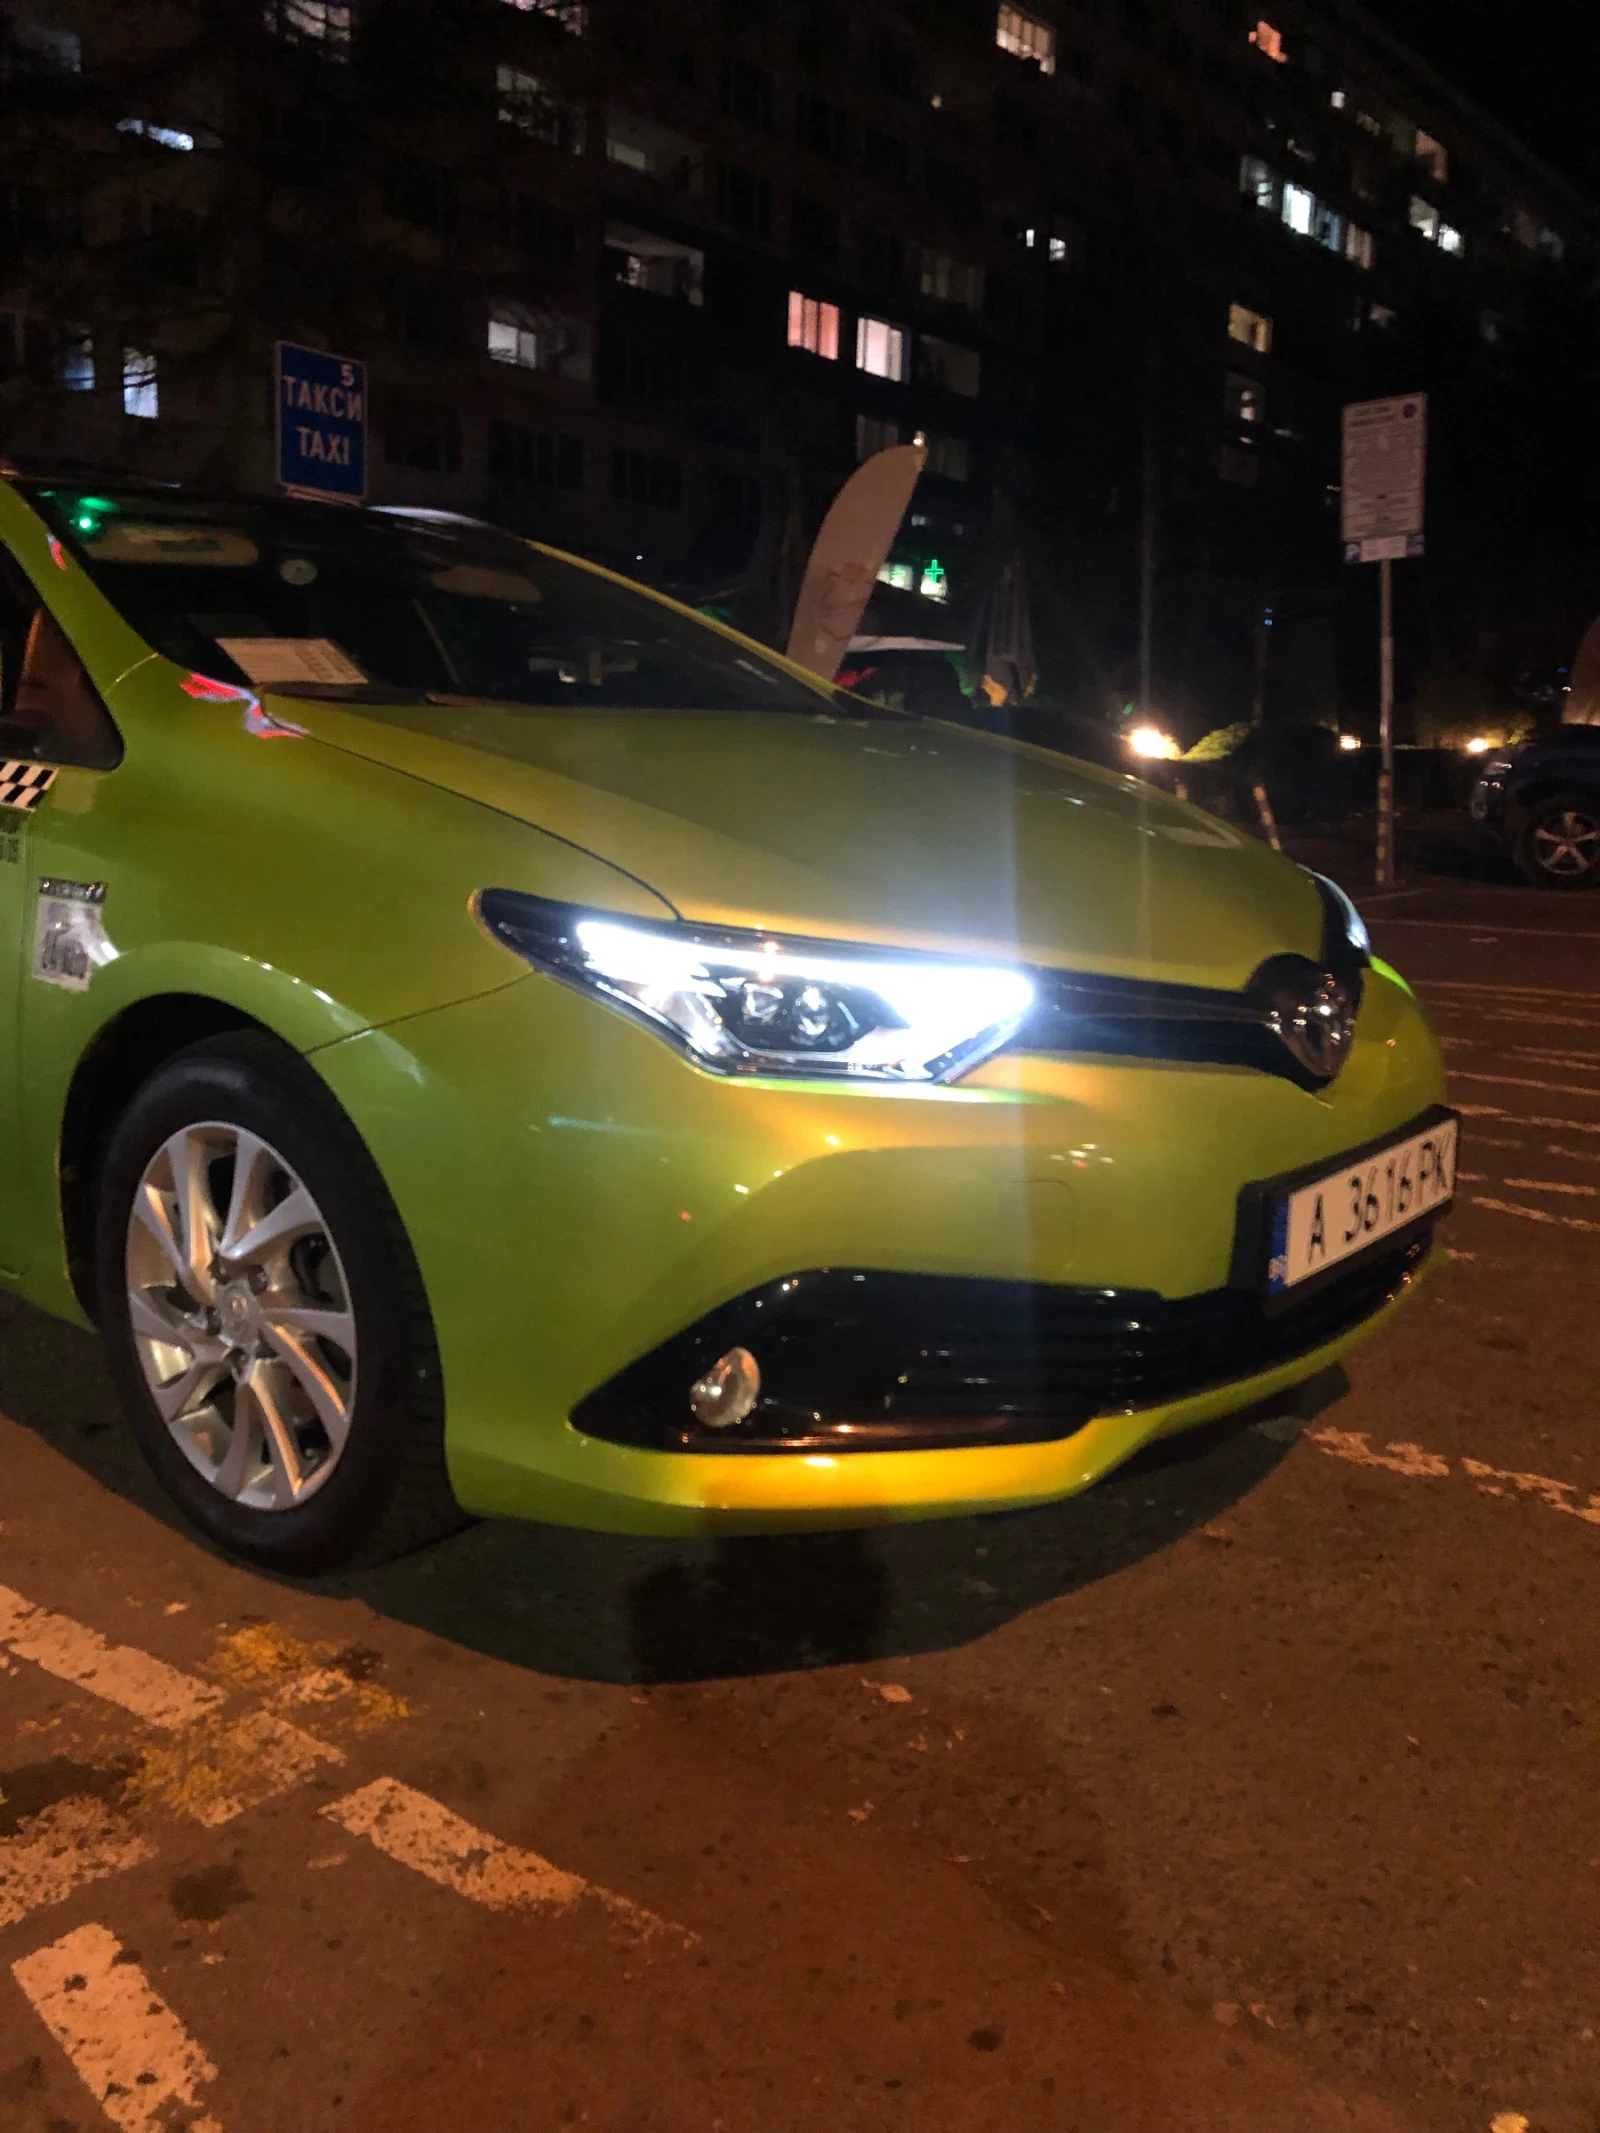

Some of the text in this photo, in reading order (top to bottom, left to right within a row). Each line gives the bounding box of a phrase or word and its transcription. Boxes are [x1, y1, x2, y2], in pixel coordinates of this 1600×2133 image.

[341, 364, 354, 386] 5
[283, 376, 362, 421] ТАКСИ
[297, 427, 350, 465] TAXI
[1307, 1191, 1326, 1266] A
